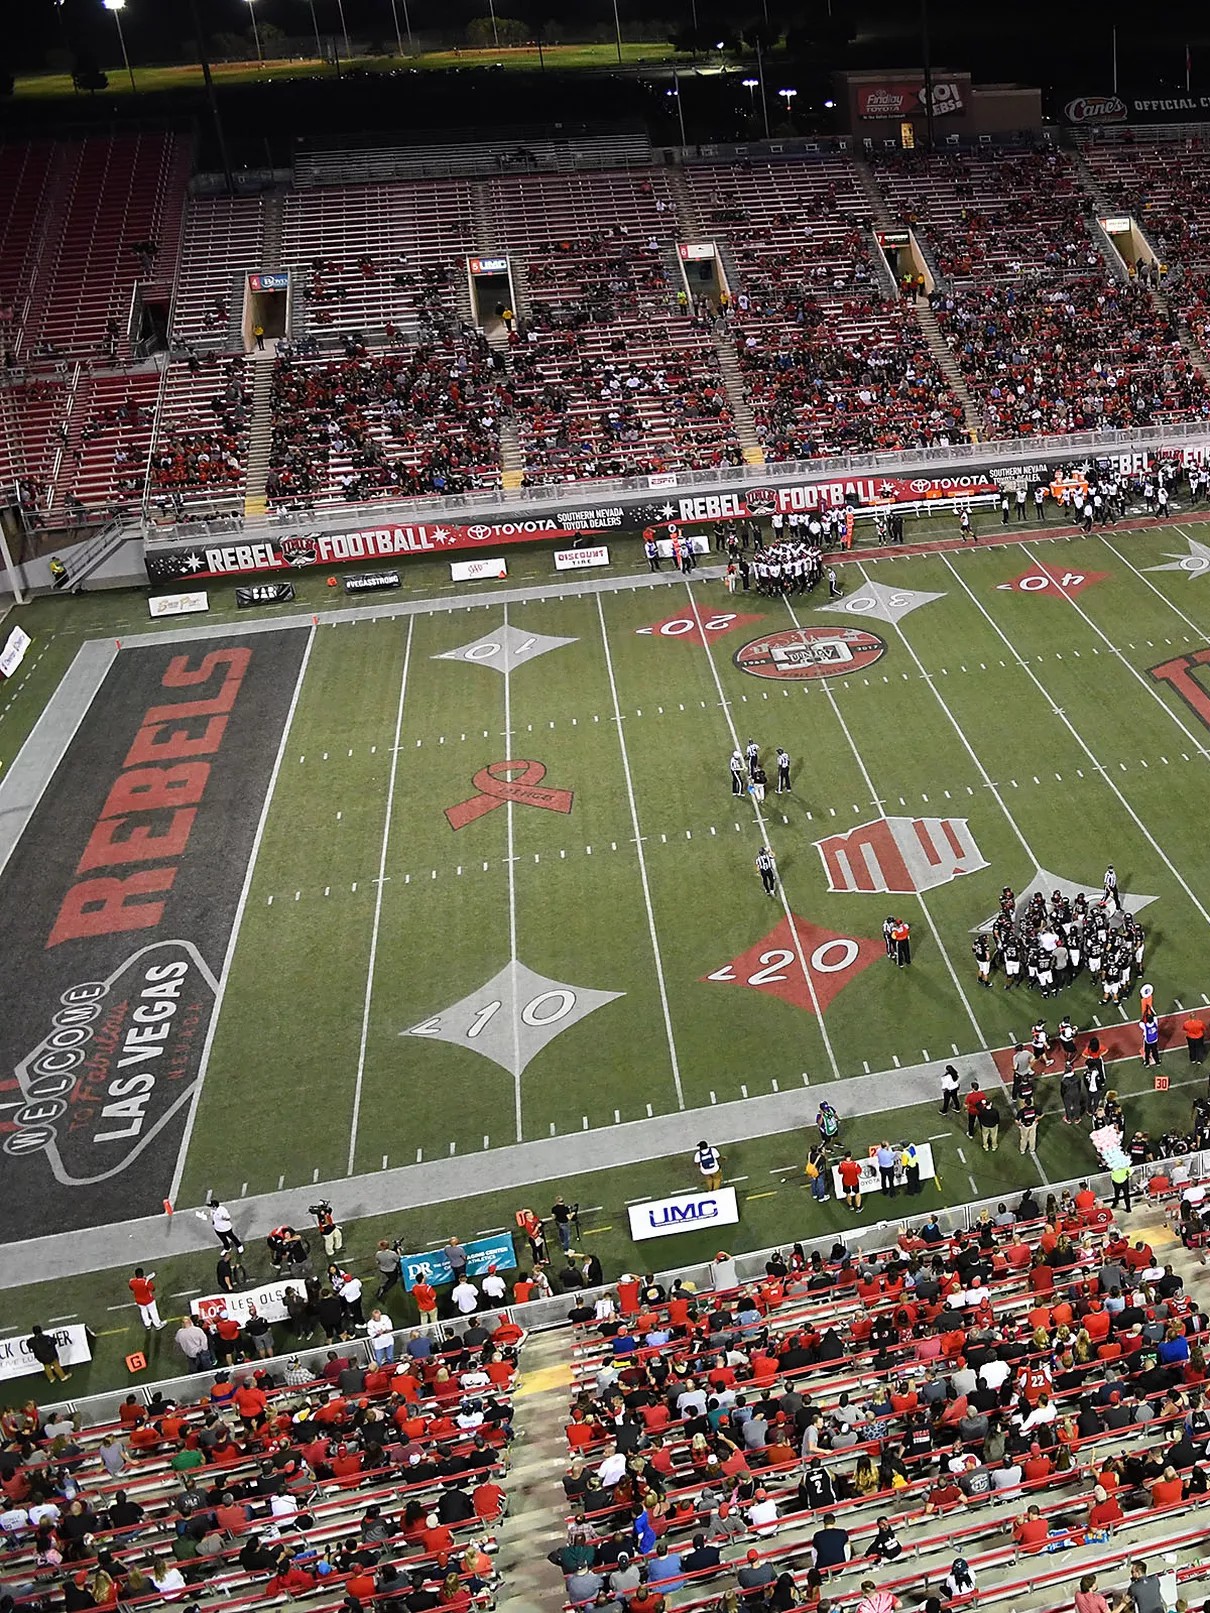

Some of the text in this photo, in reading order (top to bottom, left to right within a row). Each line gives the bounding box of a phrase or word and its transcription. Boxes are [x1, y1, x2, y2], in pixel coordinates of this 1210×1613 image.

[866, 92, 904, 106] Findlay
[1134, 98, 1197, 111] OFFICIAL
[989, 463, 1048, 478] SOUTHERN NEVADA
[931, 474, 989, 490] TOYOTA
[678, 493, 746, 522] REBEL
[778, 479, 881, 511] FOOTBALL
[557, 507, 624, 523] SOUTHERN NEVADA
[492, 519, 558, 536] TOYOTA
[562, 516, 622, 531] TOYOTA DEALERS
[205, 543, 282, 573] REBEL
[318, 527, 435, 561] FOOTBALL
[558, 550, 604, 562] DISCOUNT
[346, 575, 399, 589] #VEGASSTRONG
[1018, 571, 1087, 593] 40
[845, 592, 918, 614] 30
[659, 613, 739, 637] 20
[465, 637, 537, 661] 10
[45, 646, 253, 950] REBELS
[747, 938, 861, 987] 20
[466, 988, 577, 1039] 10
[93, 961, 189, 1143] LAS VEGAS
[8, 984, 104, 1151] WELCOME
[1156, 1077, 1168, 1089] 30
[860, 1177, 881, 1187] OYOTA
[649, 1199, 719, 1228] UMC
[467, 1255, 496, 1264] ATHLETICS
[407, 1262, 433, 1280] DR
[231, 1297, 254, 1311] LES
[131, 1355, 142, 1369] G
[1031, 1374, 1045, 1388] 22
[814, 1479, 823, 1493] 2
